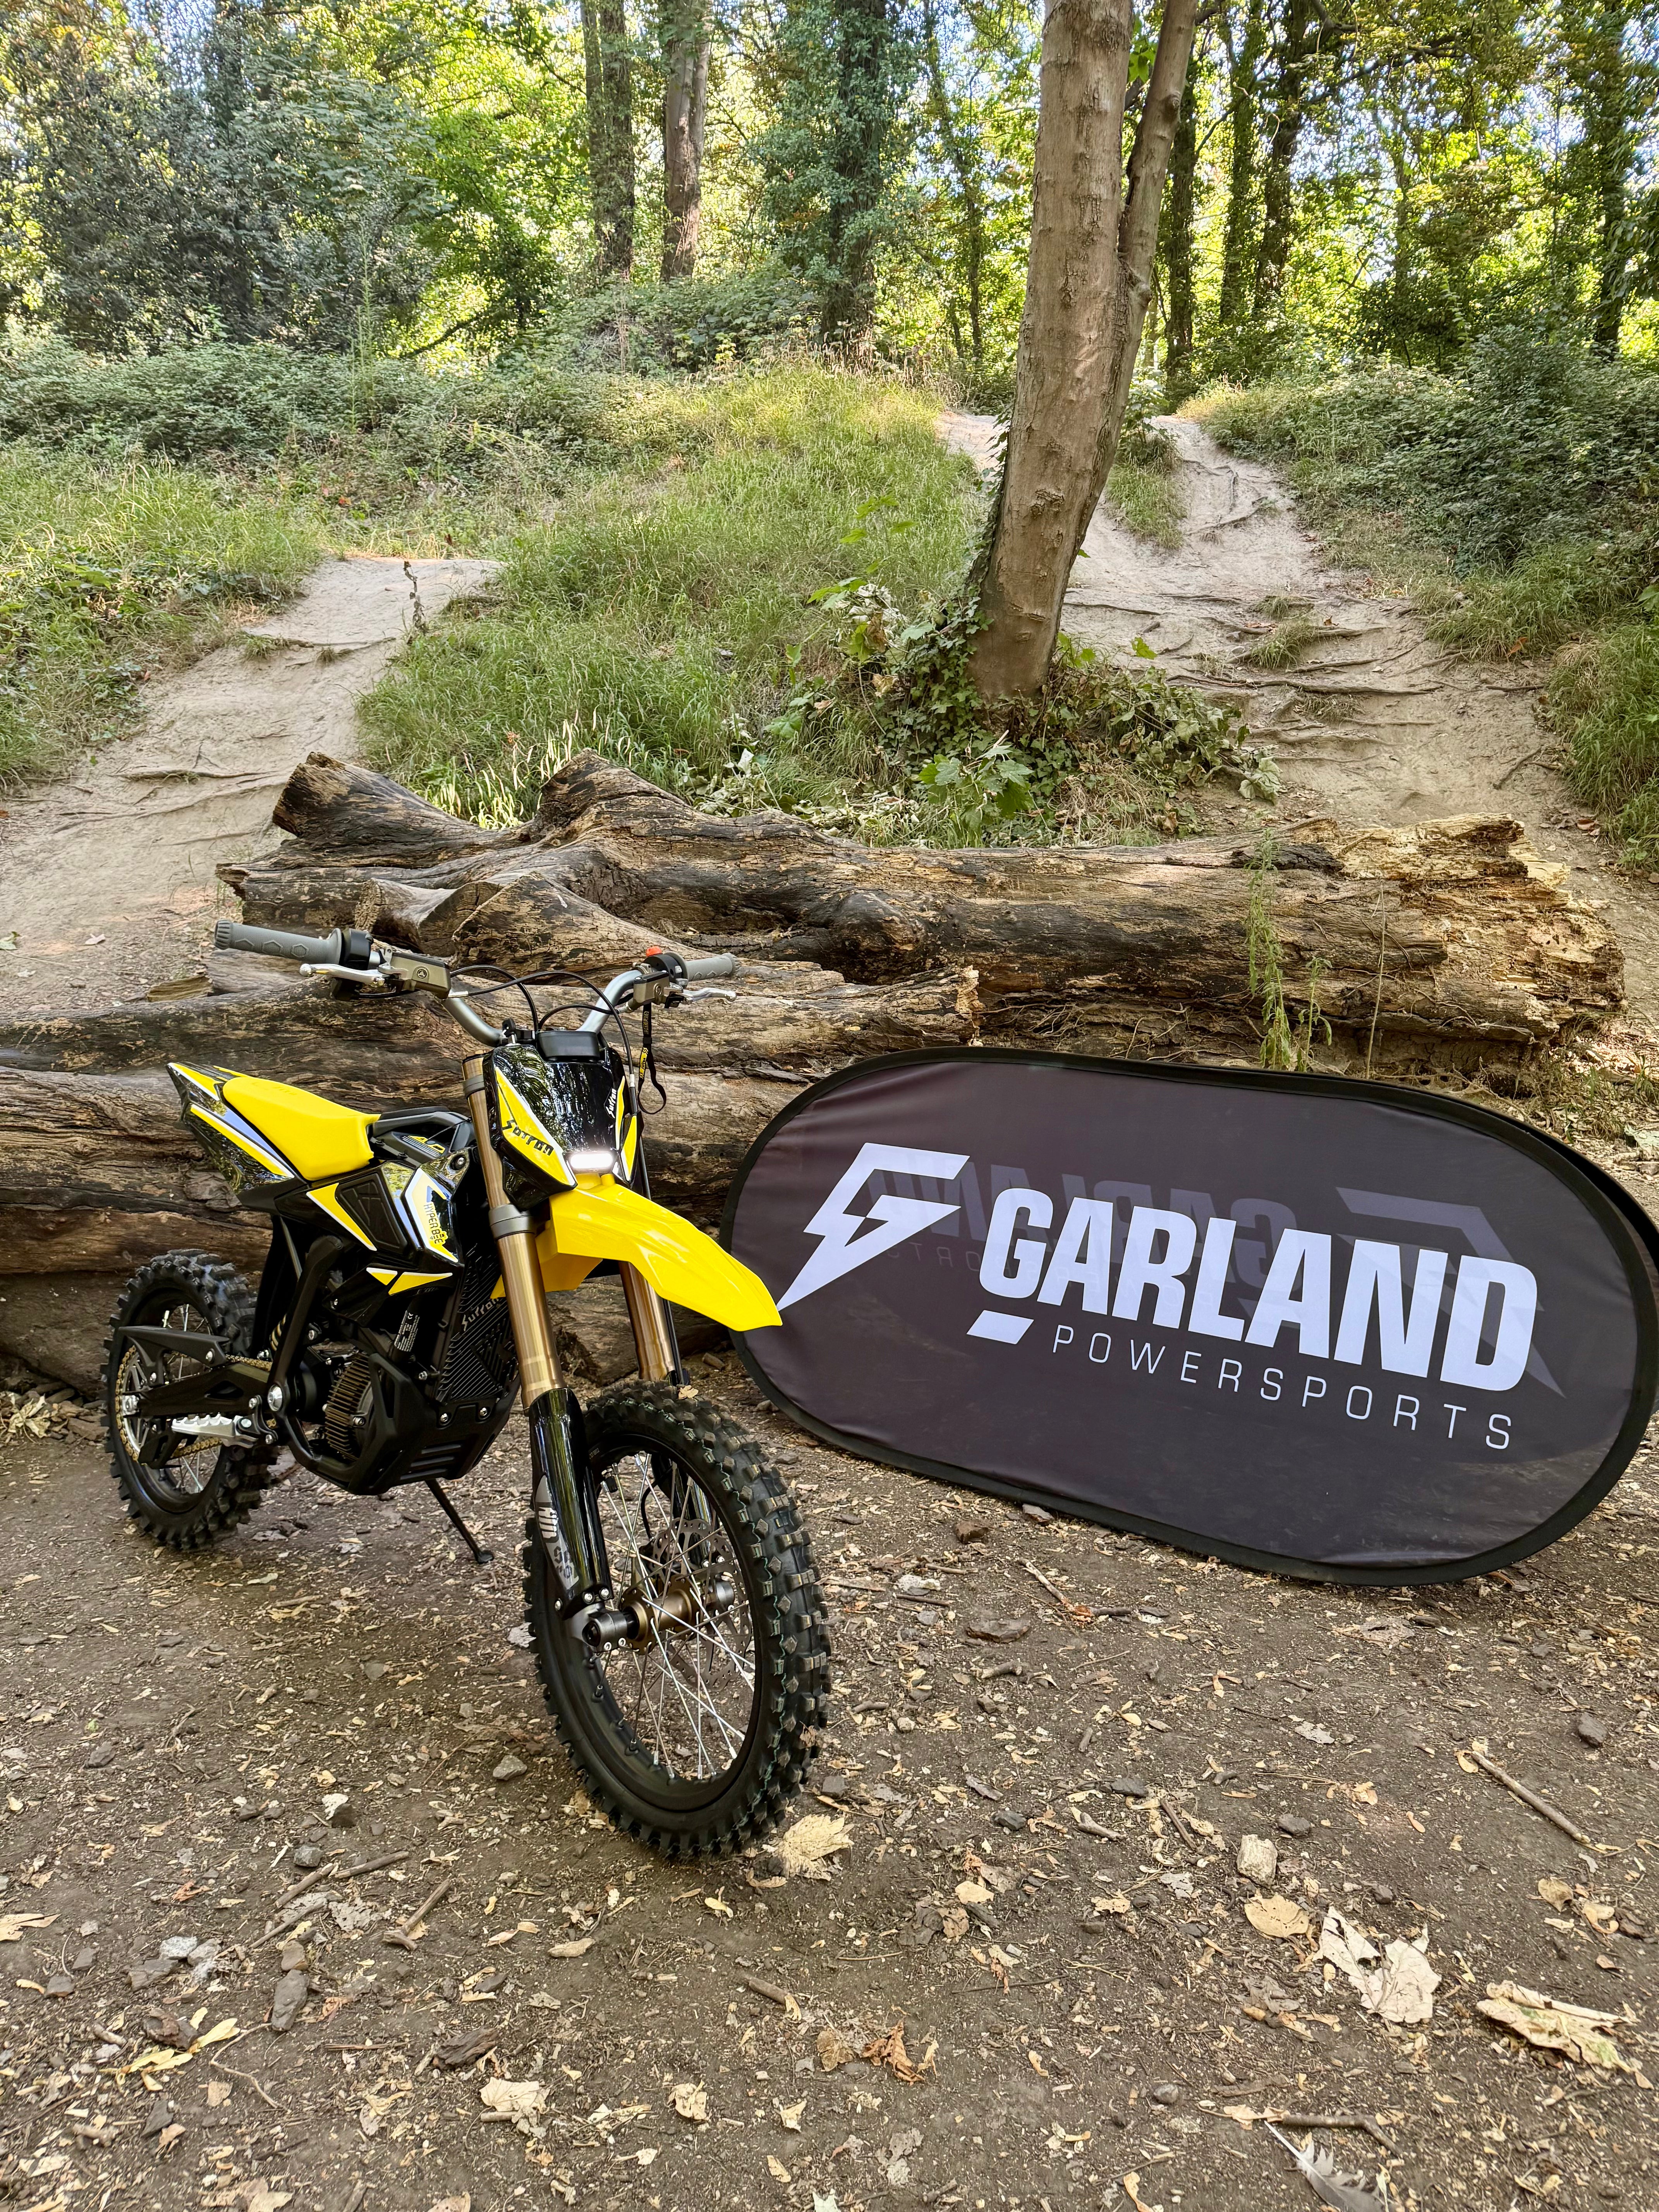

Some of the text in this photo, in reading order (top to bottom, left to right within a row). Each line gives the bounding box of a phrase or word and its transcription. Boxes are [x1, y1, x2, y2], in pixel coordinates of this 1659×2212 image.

[606, 1088, 617, 1118] Surron
[502, 1119, 554, 1156] Surron
[424, 1203, 439, 1229] HYPER
[980, 1188, 1537, 1391] GARLAND
[1053, 1324, 1511, 1449] POWERSPORTS
